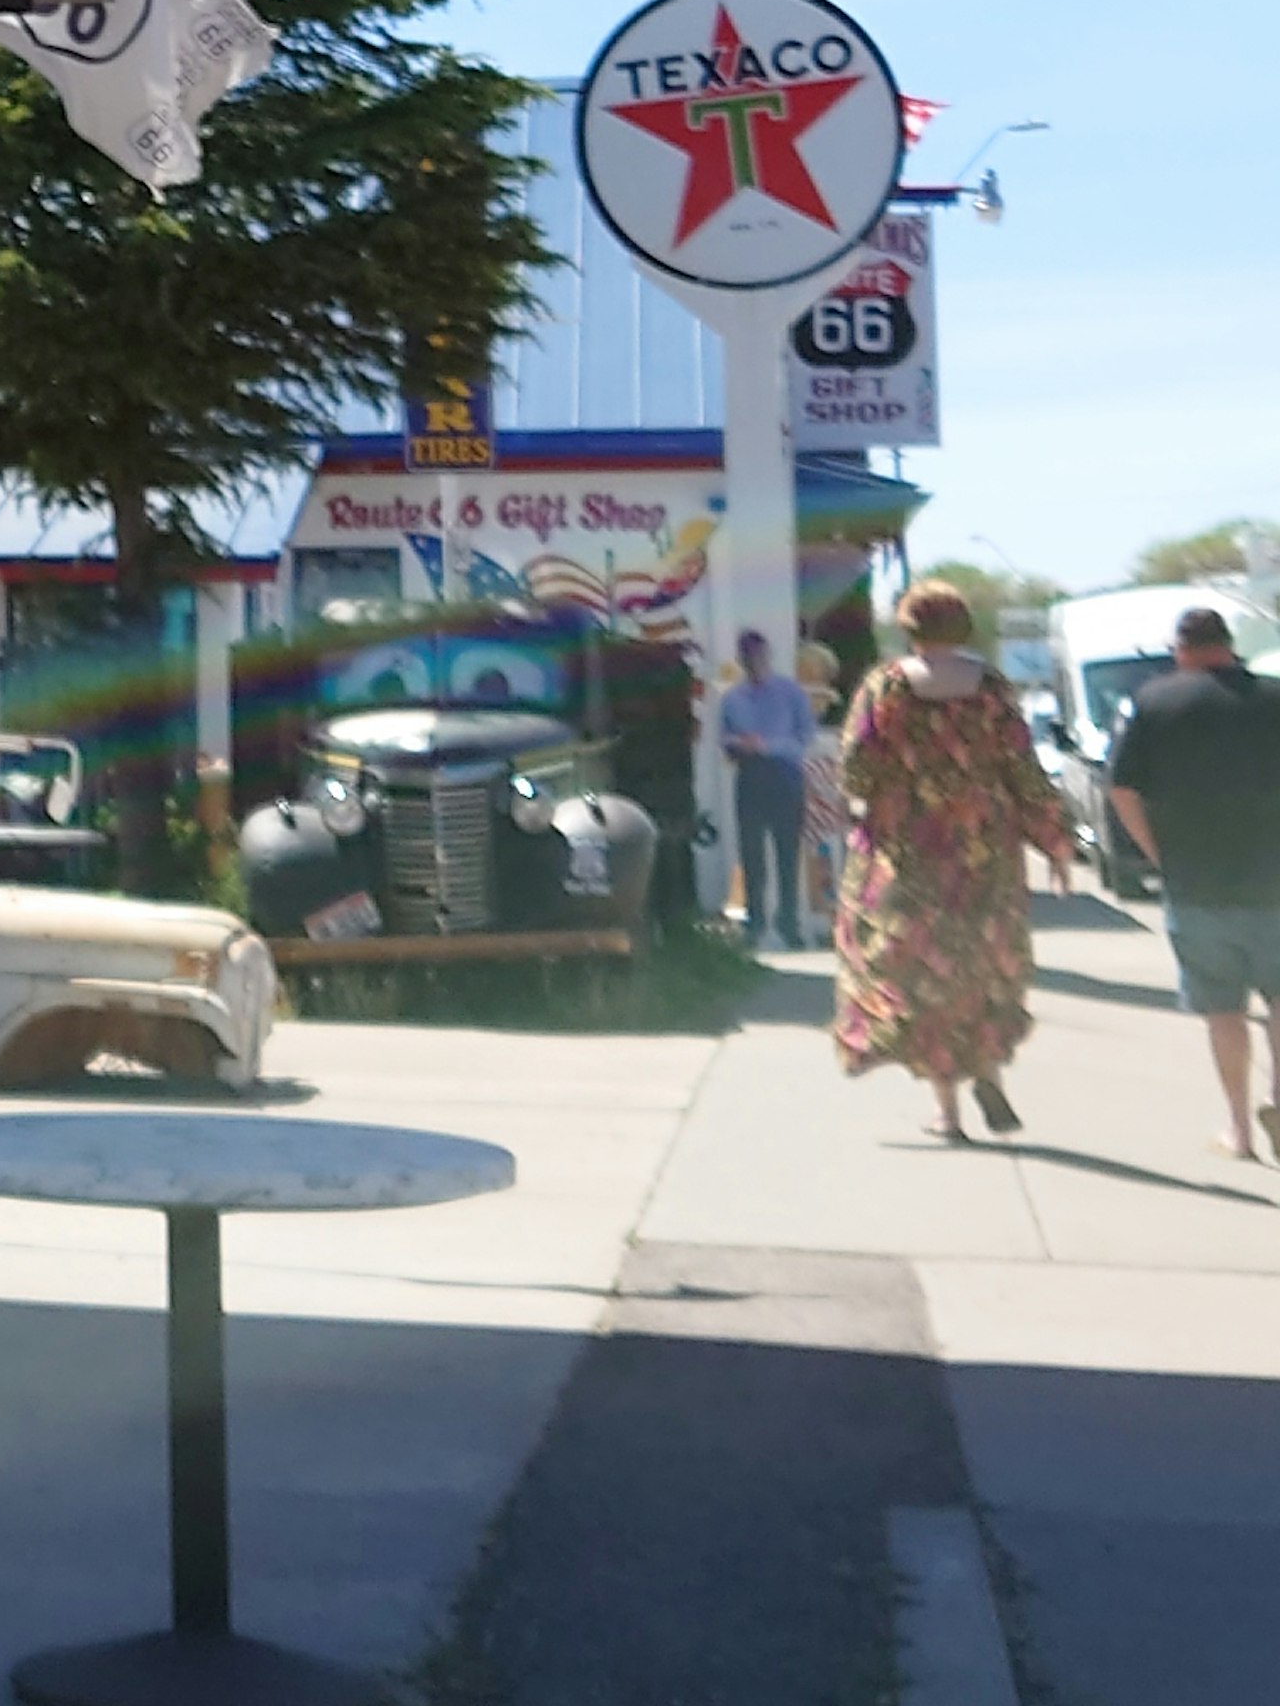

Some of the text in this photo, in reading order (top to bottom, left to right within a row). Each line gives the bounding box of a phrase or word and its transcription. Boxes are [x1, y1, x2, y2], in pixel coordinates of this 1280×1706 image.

[615, 33, 854, 99] TEXACO
[811, 297, 893, 355] 66
[805, 401, 907, 424] SHOP
[410, 437, 490, 464] TIRES
[326, 495, 423, 531] Route
[496, 491, 569, 546] Gift
[578, 491, 668, 548] Shop
